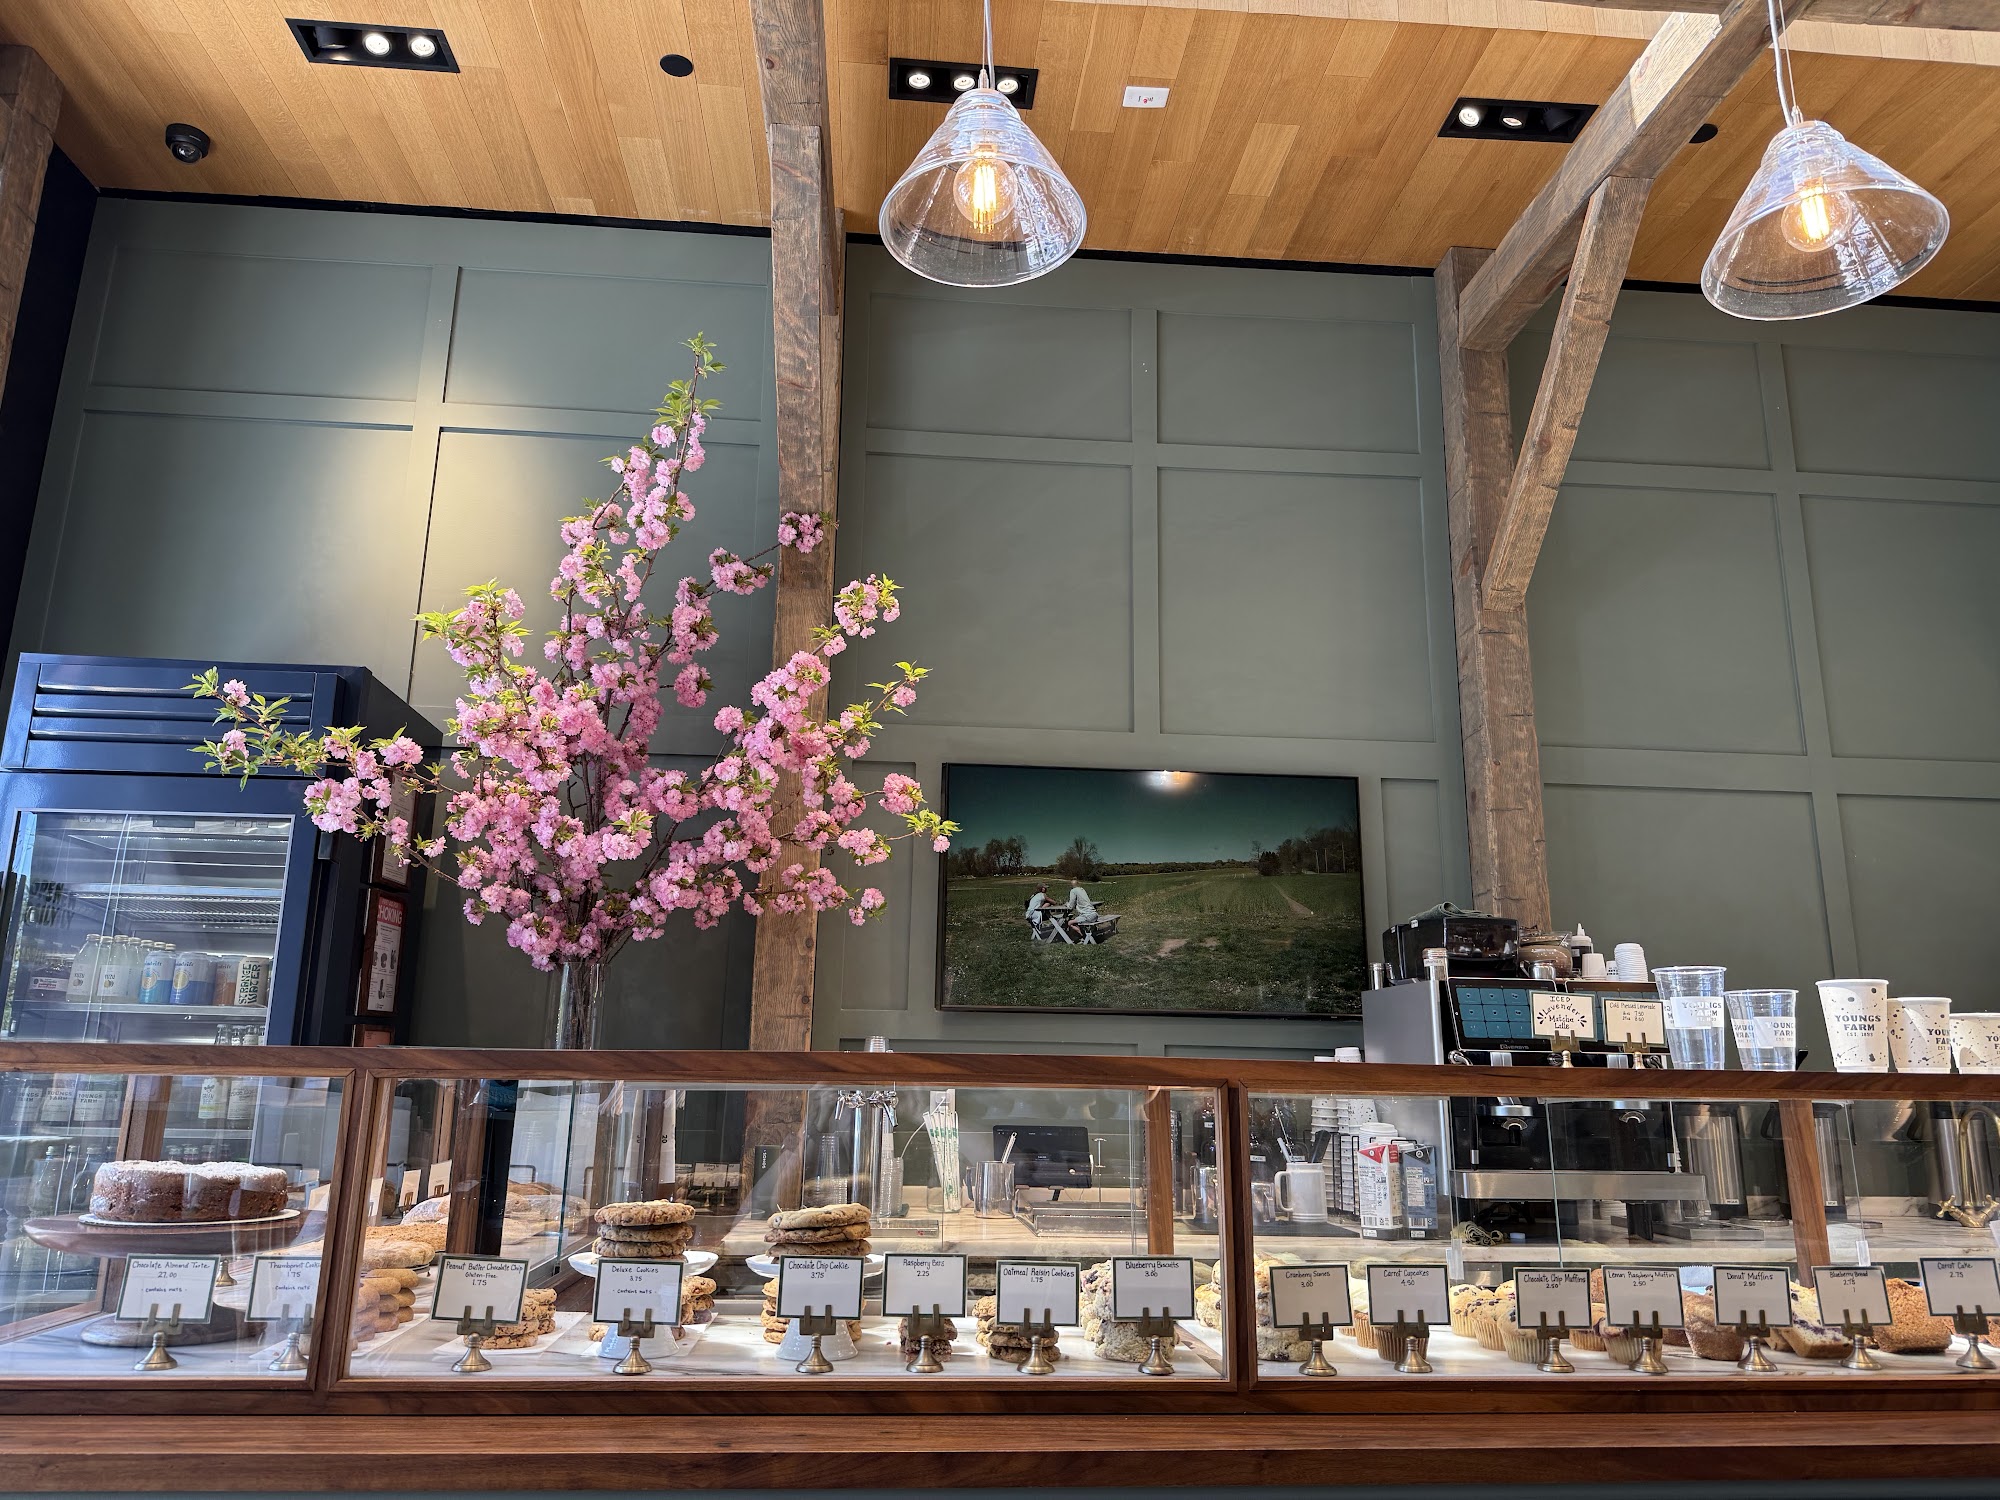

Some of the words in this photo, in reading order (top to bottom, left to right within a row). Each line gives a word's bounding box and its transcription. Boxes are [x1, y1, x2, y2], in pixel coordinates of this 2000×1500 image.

[238, 963, 252, 1004] STRANGE
[247, 964, 262, 1004] WATER
[1549, 995, 1571, 1003] ICED
[1543, 1002, 1580, 1015] Lavender
[1549, 1015, 1574, 1023] Matcha
[1834, 1014, 1881, 1022] YOUNGS
[1844, 1023, 1875, 1031] FARM
[132, 1261, 162, 1269] Chocolate
[268, 1261, 304, 1271] Thumbprint
[445, 1261, 466, 1270] Peanut
[468, 1262, 485, 1271] Butter
[486, 1263, 510, 1271] Chocolate
[510, 1264, 523, 1274] Chip
[611, 1265, 633, 1273] Deluxe
[788, 1260, 815, 1270] Chocolate
[816, 1260, 829, 1272] Chip
[829, 1261, 850, 1270] Cookie
[903, 1259, 931, 1270] Raspberry
[931, 1259, 945, 1267] Bars
[1125, 1261, 1156, 1271] Blueberry
[1156, 1261, 1180, 1269] Biscuits
[1937, 1262, 1955, 1270] Carrot
[810, 1271, 825, 1279] 3.75
[1003, 1267, 1029, 1276] Oatmeal
[1030, 1267, 1050, 1277] Raisin
[1051, 1268, 1075, 1277] Cookies
[1285, 1270, 1313, 1280] Cranberry
[1383, 1269, 1403, 1278] Carrot
[1403, 1269, 1430, 1279] Cupcakes
[1608, 1270, 1626, 1278] Lemon
[1627, 1271, 1654, 1281] Raspberry
[1726, 1271, 1746, 1280] Donut
[1747, 1271, 1774, 1281] Muffins
[1829, 1271, 1855, 1280] Blueberry
[1523, 1274, 1550, 1283] Chocolate
[1550, 1274, 1563, 1285] Chip
[1564, 1273, 1586, 1283] Muffins
